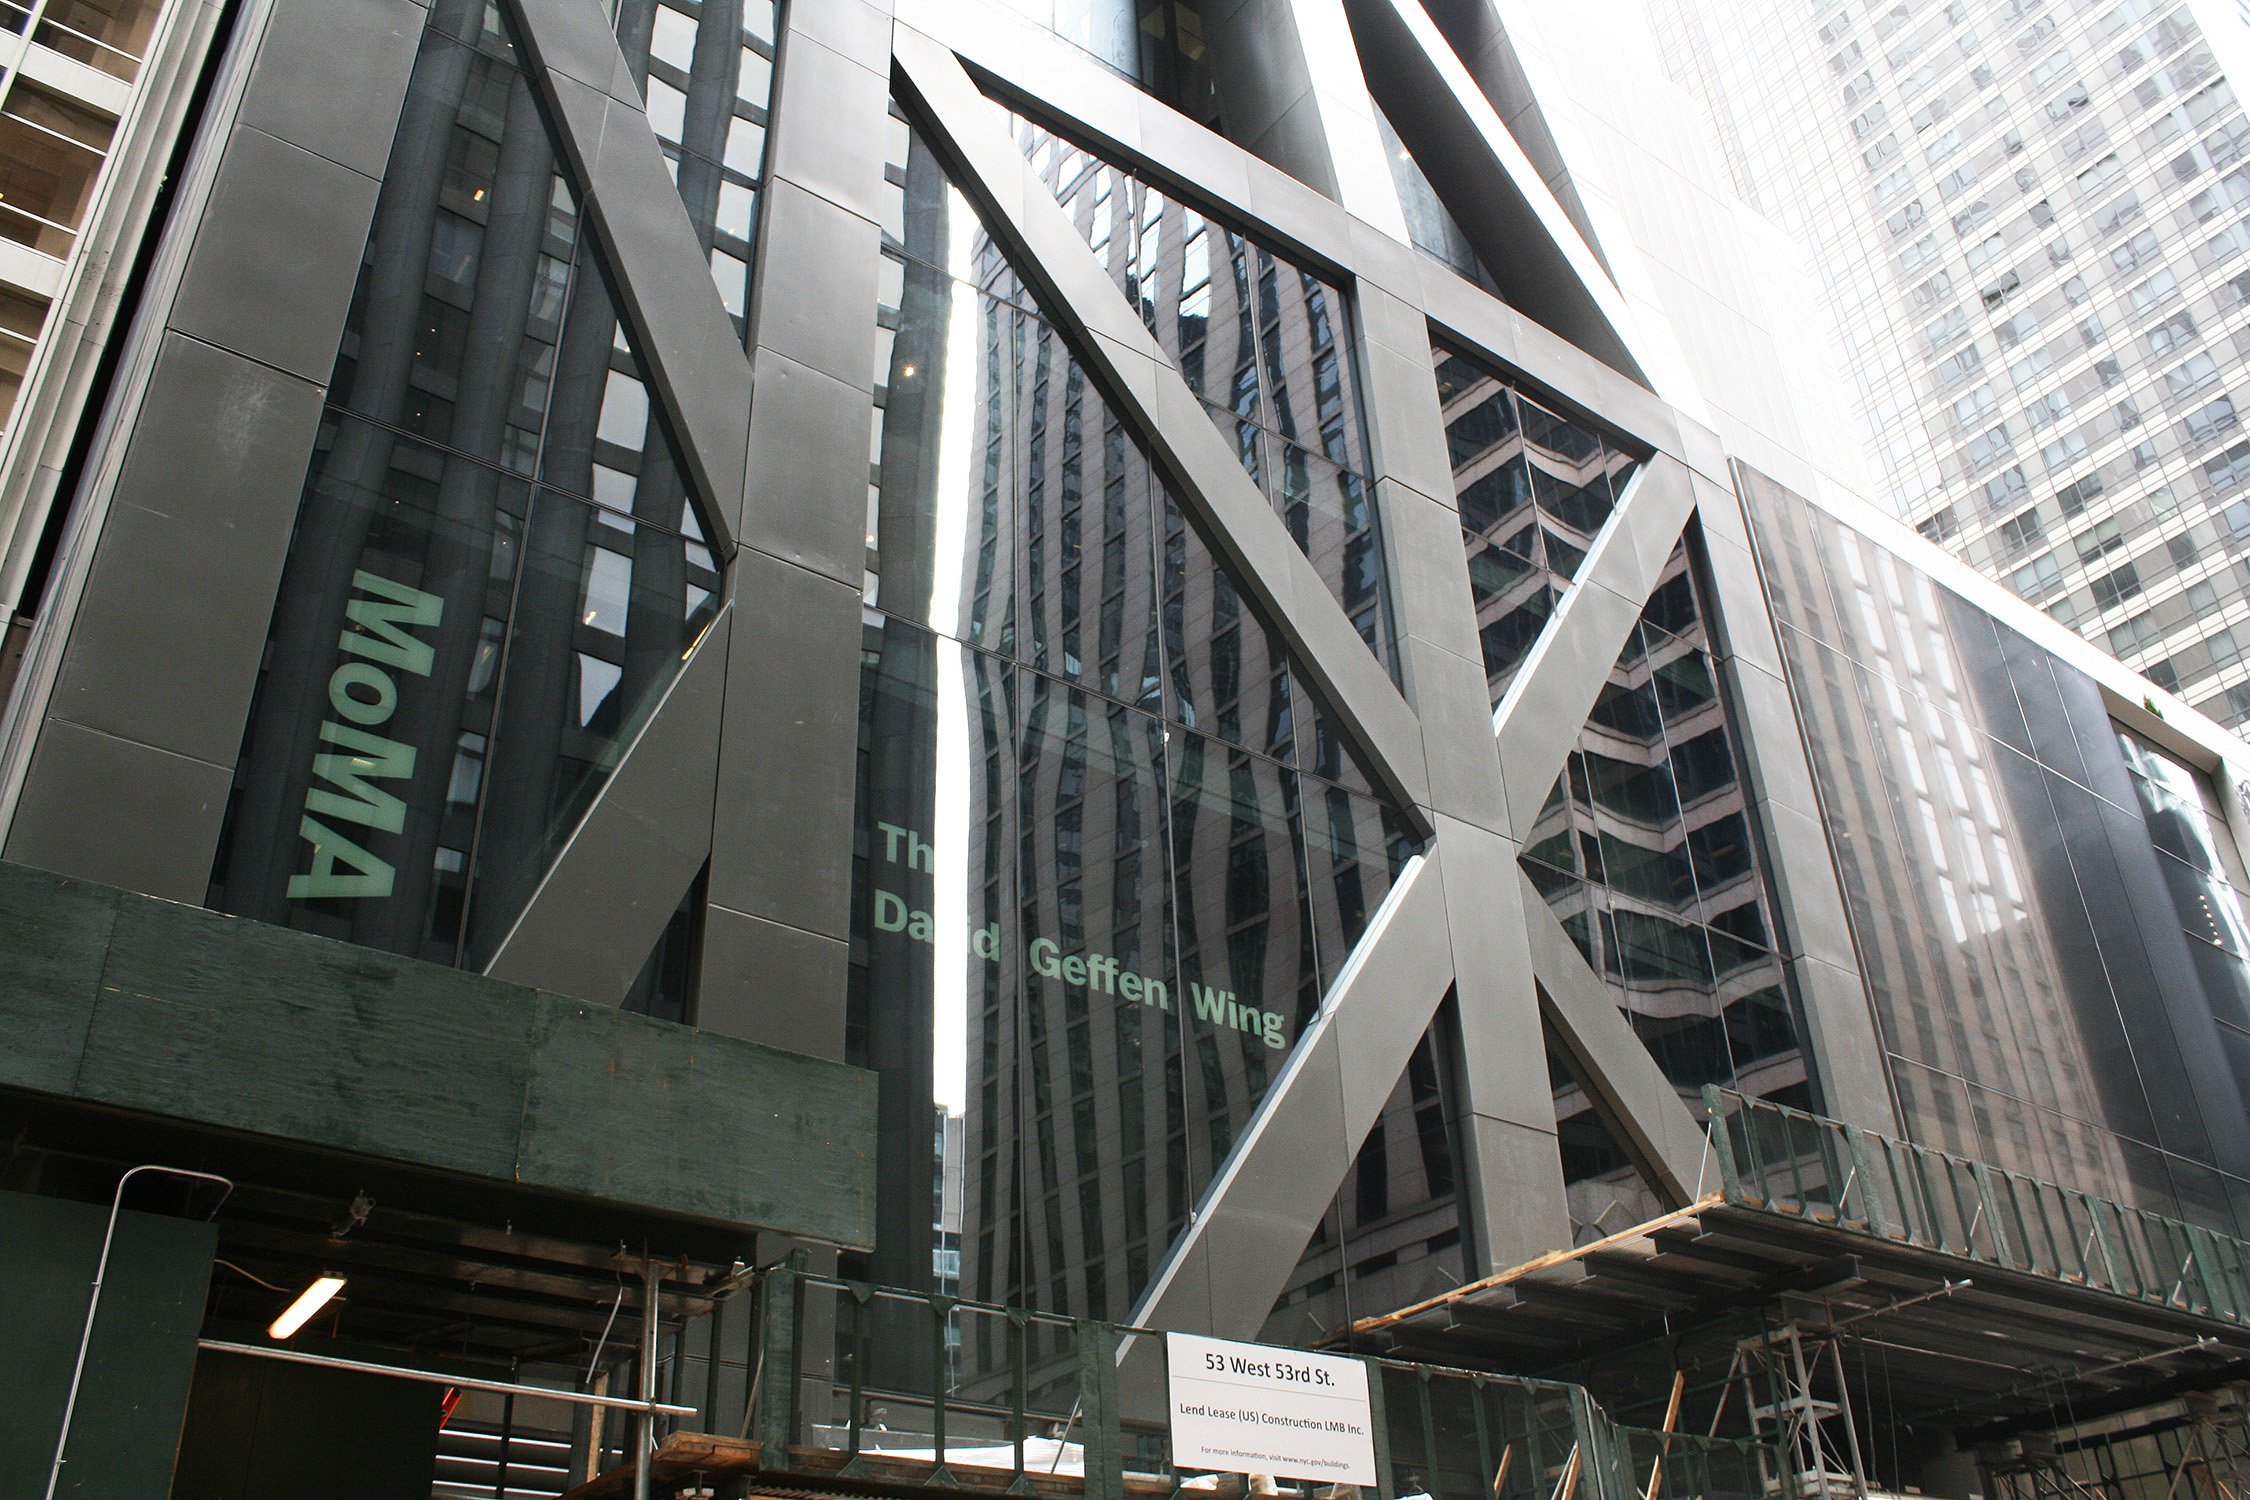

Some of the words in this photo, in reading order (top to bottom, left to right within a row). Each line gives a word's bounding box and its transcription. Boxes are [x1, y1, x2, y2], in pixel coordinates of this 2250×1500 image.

[286, 569, 444, 898] MoMA
[877, 821, 935, 875] Th
[874, 888, 1000, 962] Dad
[1029, 937, 1168, 1010] Geffen
[1190, 981, 1286, 1049] Wing
[1205, 1353, 1225, 1371] 53
[1230, 1356, 1271, 1378] West
[1275, 1362, 1311, 1383] 53rd
[1315, 1368, 1335, 1387] St.
[1180, 1402, 1205, 1416] Lend
[1208, 1405, 1236, 1420] Lease
[1238, 1408, 1259, 1425] (US)
[1261, 1412, 1323, 1431] Construction
[1324, 1420, 1346, 1433] LMB
[1347, 1423, 1365, 1436] Inc.
[1200, 1446, 1211, 1454] For
[1212, 1448, 1229, 1457] more
[1269, 1454, 1281, 1462] visit
